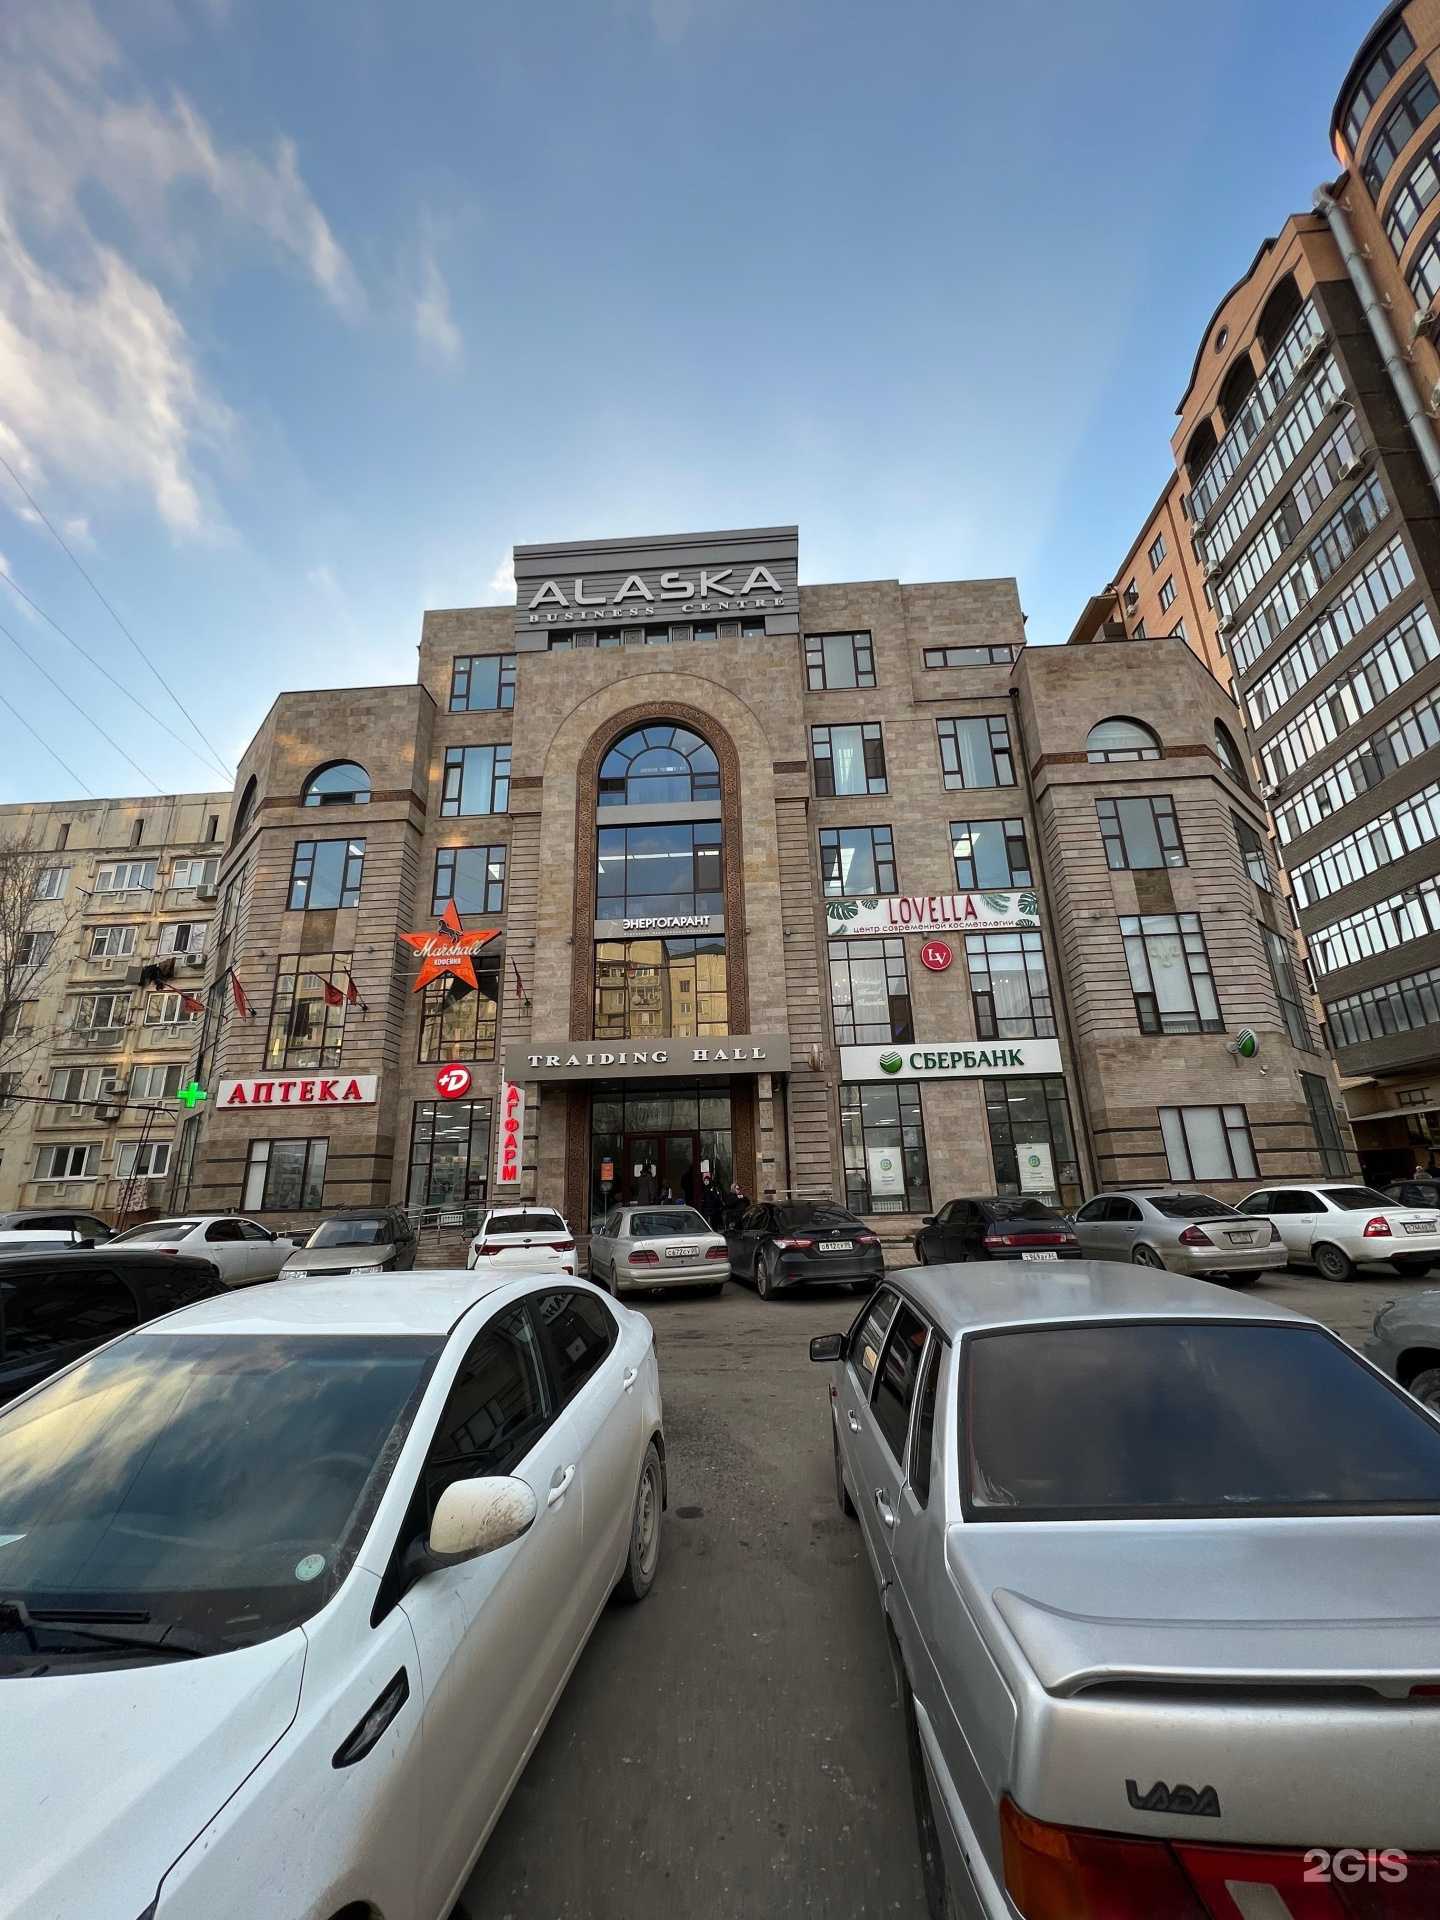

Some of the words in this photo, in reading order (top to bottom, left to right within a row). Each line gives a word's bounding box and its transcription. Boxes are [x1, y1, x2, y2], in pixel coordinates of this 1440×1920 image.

[528, 566, 783, 610] ALASKA
[529, 606, 656, 624] BUSINESS
[681, 598, 786, 614] CENTRE
[889, 894, 978, 925] LOVELLA
[623, 915, 710, 931] ЭНЕРГОГАРАНТ
[853, 926, 880, 934] центр
[882, 921, 948, 932] современной
[948, 919, 1016, 930] косметологии
[413, 938, 485, 957] Marshall
[527, 1050, 669, 1067] TRAIDING
[691, 1047, 768, 1062] HALL
[910, 1048, 1025, 1070] СБЕРБАНК
[227, 1079, 364, 1105] АПТЕКА
[502, 1081, 520, 1181] АГФАРМ
[1125, 1779, 1221, 1818] LADA
